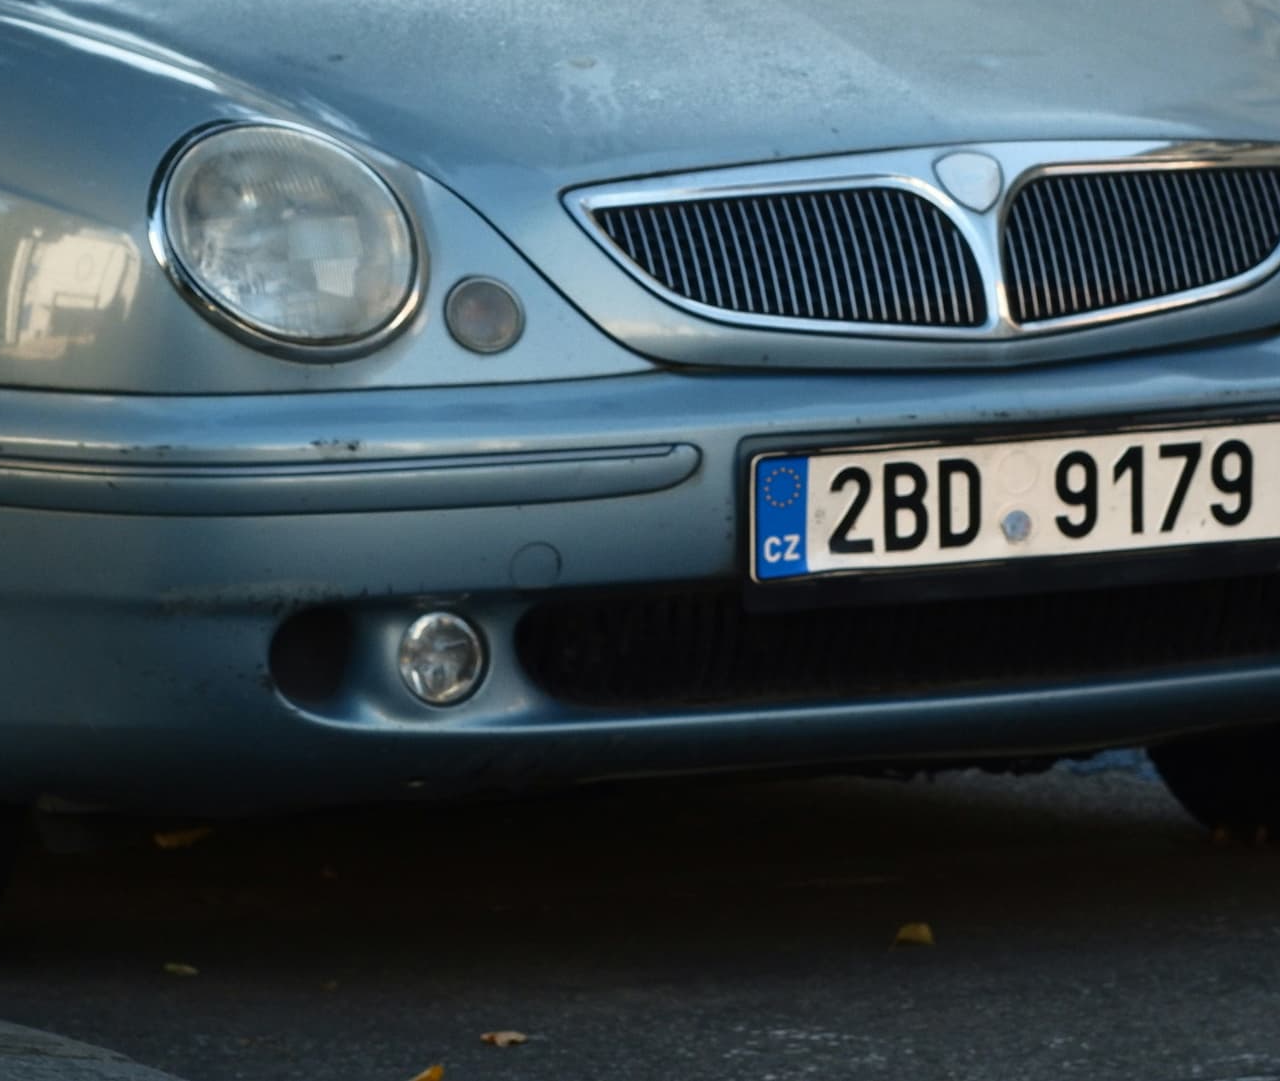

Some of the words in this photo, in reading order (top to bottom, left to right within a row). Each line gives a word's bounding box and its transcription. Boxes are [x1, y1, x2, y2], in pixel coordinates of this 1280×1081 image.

[828, 457, 982, 555] 2BD
[1054, 438, 1254, 539] 9179
[763, 533, 801, 563] CZ
